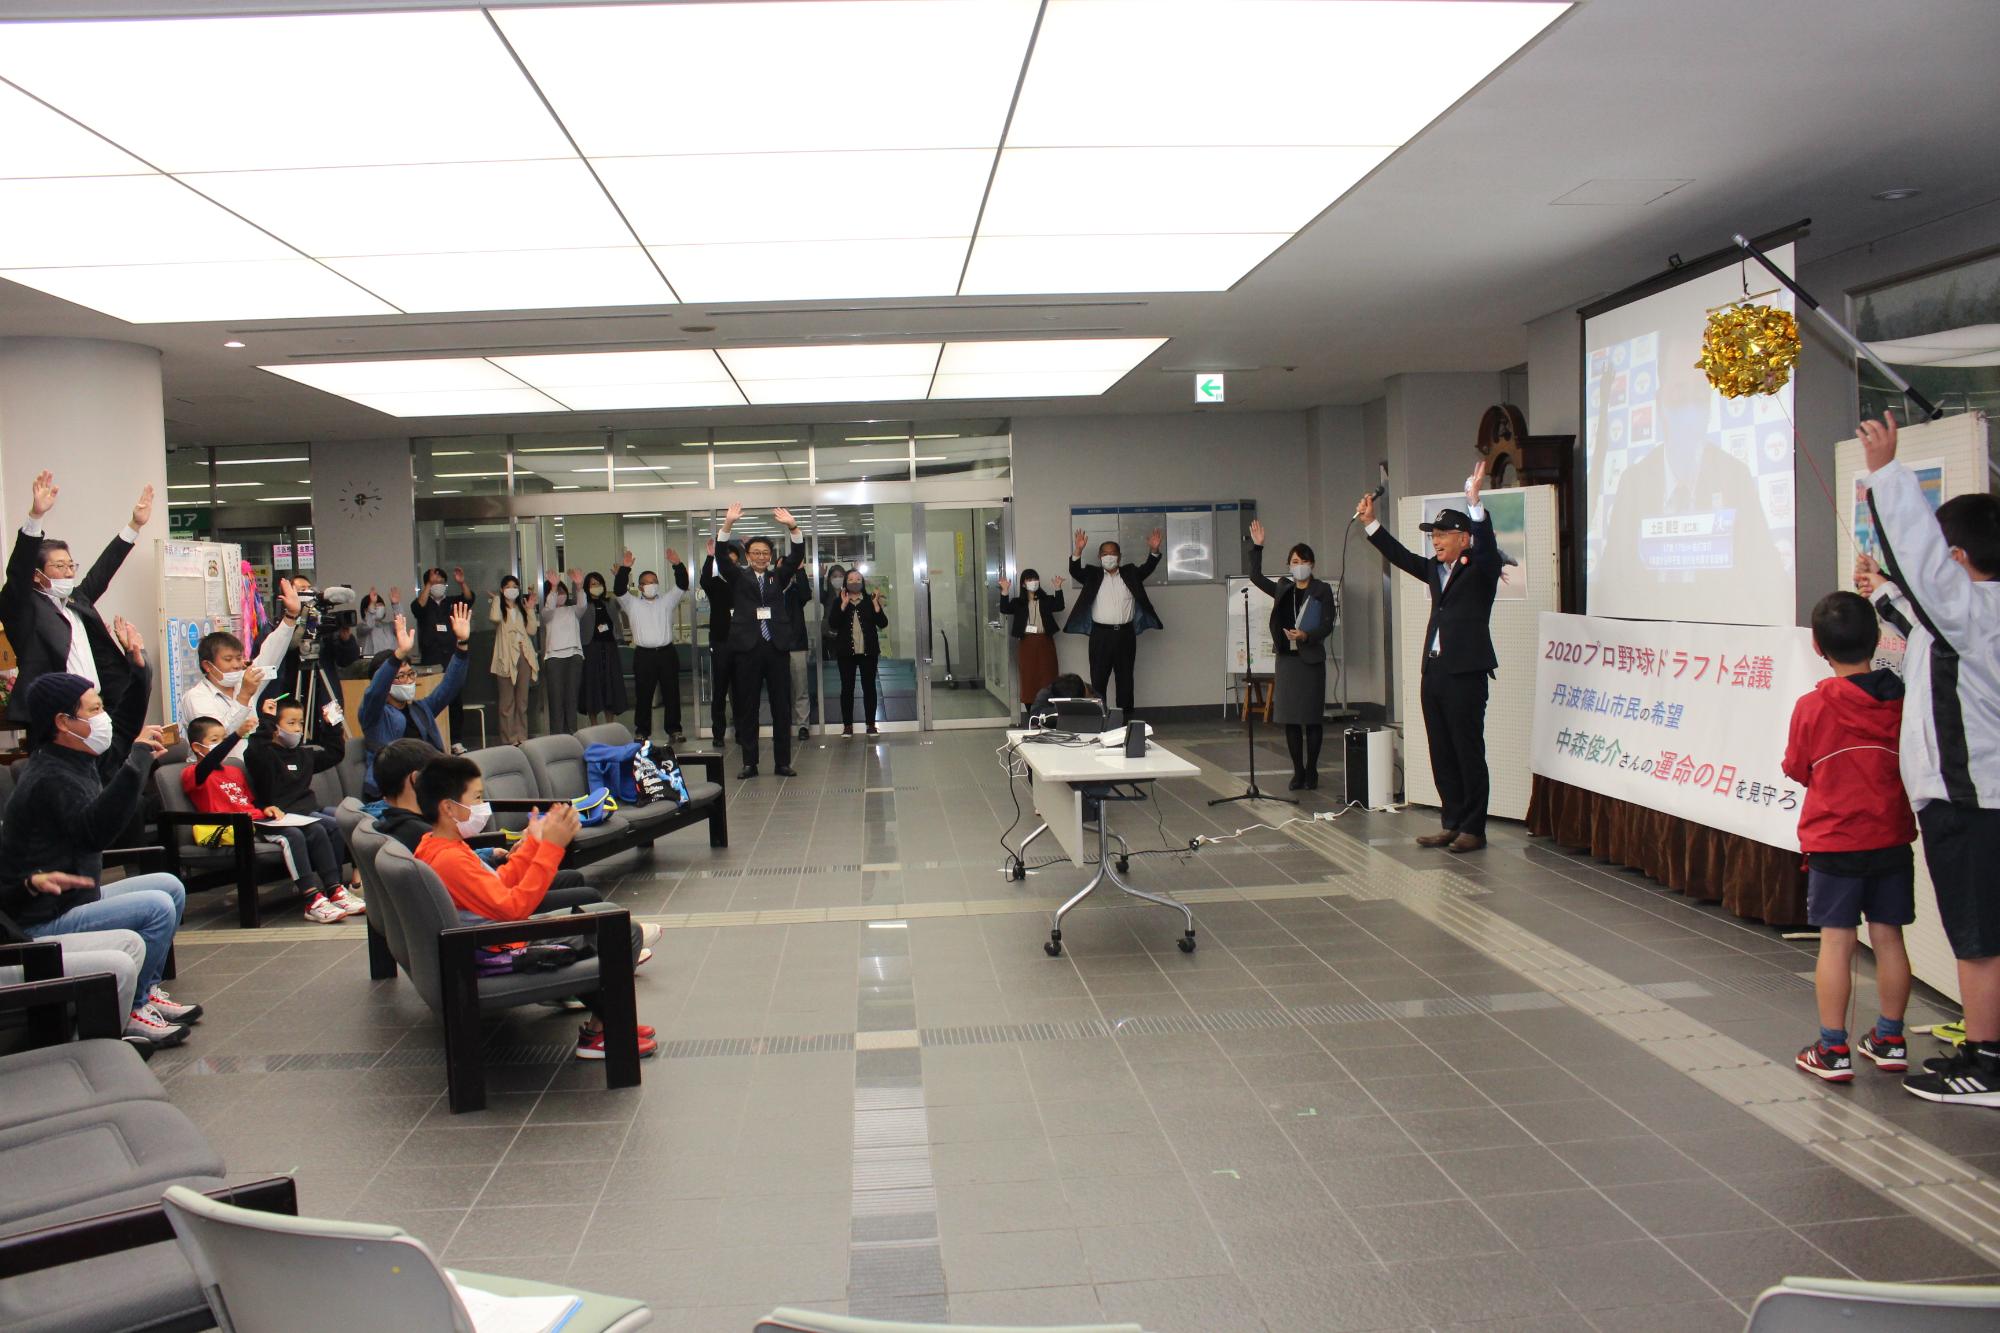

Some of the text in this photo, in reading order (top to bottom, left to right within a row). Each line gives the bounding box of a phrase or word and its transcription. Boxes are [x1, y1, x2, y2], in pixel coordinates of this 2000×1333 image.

[1544, 640, 1775, 690] 2020プロ野球ドラフト会議
[1551, 683, 1684, 730] 丹波篠山市民の希望
[1555, 727, 1797, 811] 中森俊介さんの運命の日を見守ろ
